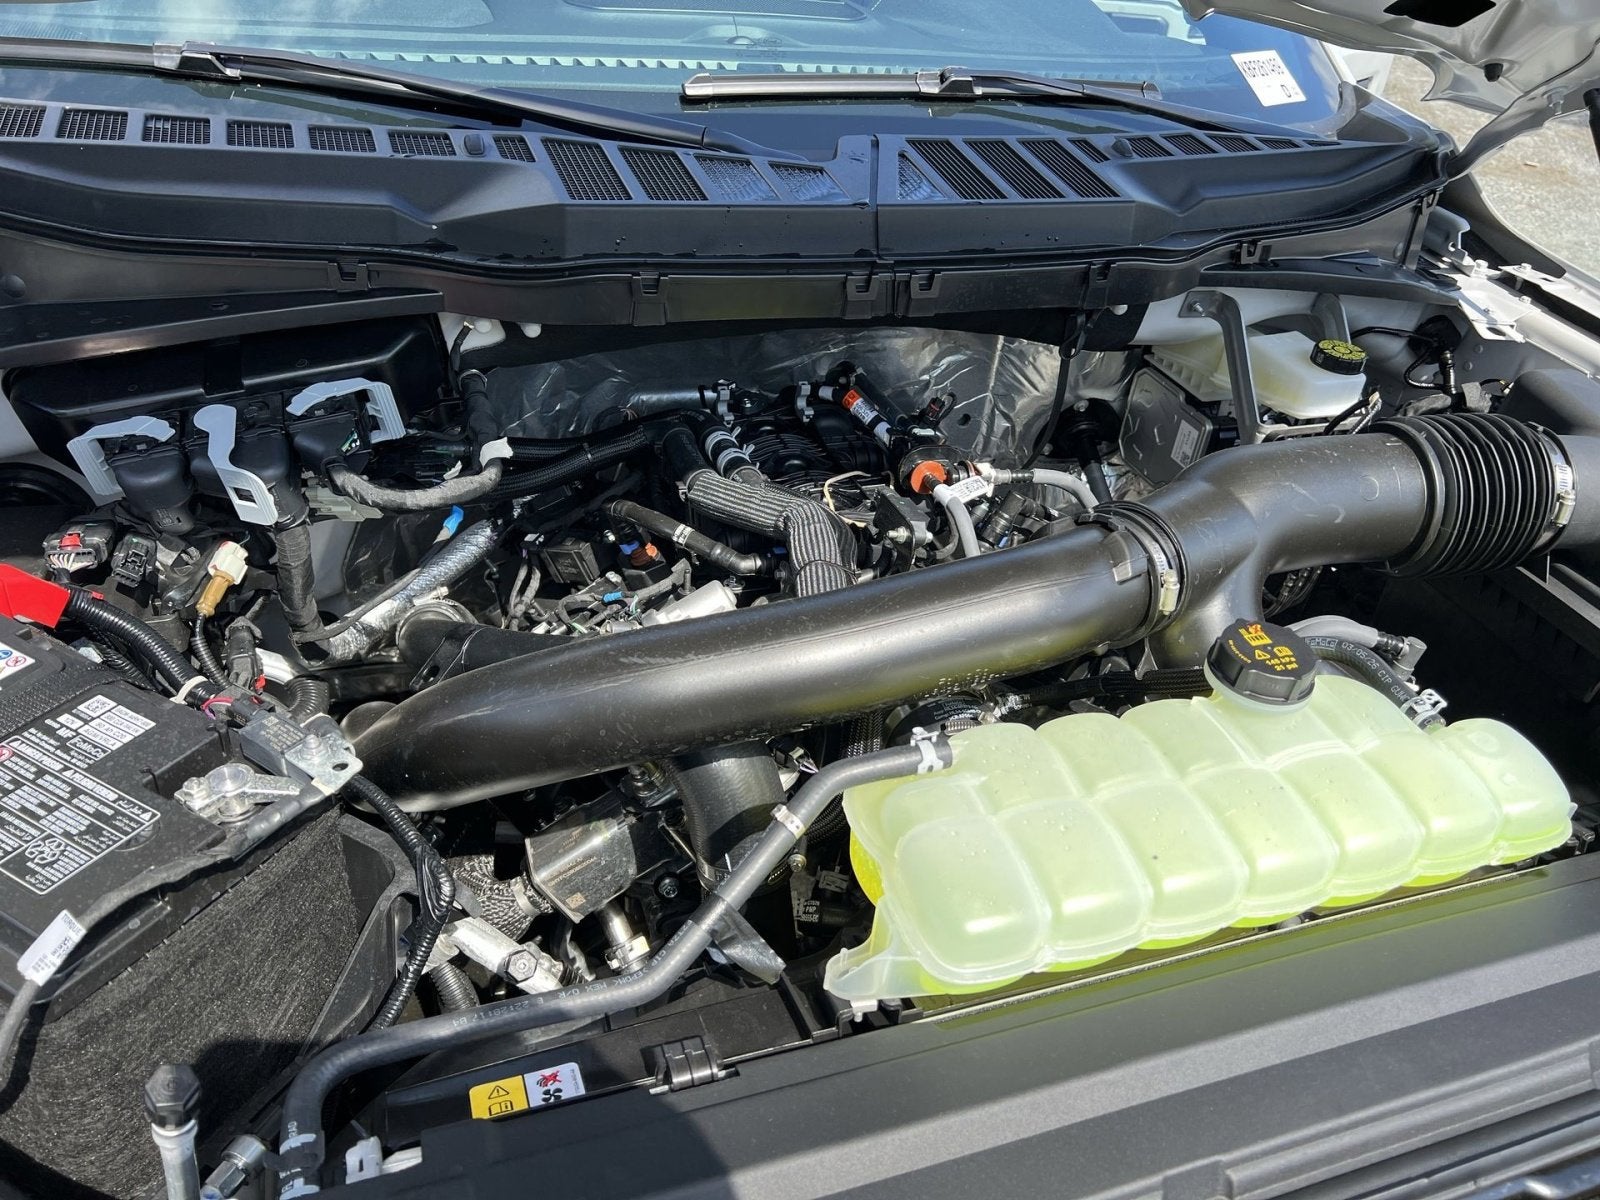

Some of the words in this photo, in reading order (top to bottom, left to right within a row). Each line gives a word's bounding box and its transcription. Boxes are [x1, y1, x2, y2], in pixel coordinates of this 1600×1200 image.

[1306, 637, 1337, 649] FoMoCo
[1341, 641, 1380, 670] 03/05/26
[1377, 669, 1393, 685] CIP
[72, 737, 105, 758] FoMoCo
[60, 912, 83, 937] TORQUE
